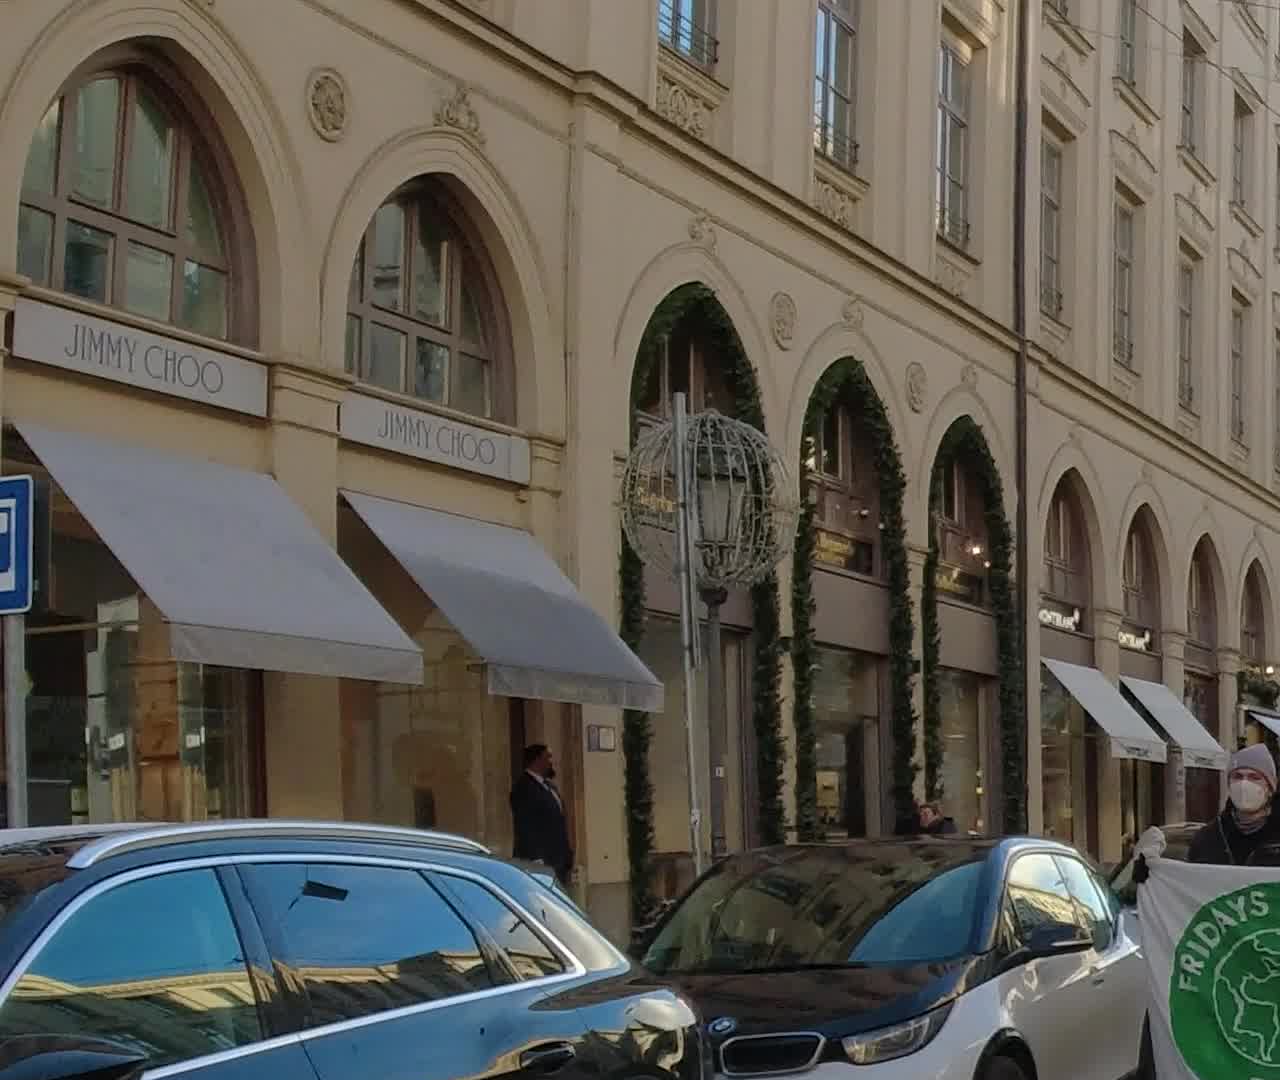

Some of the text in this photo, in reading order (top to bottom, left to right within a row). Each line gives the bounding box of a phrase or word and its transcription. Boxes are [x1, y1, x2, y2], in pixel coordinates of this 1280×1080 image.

[64, 323, 224, 394] JIMMY CHOO
[377, 409, 496, 465] JIMMY CHOO
[1178, 890, 1270, 993] FRIDAYS
